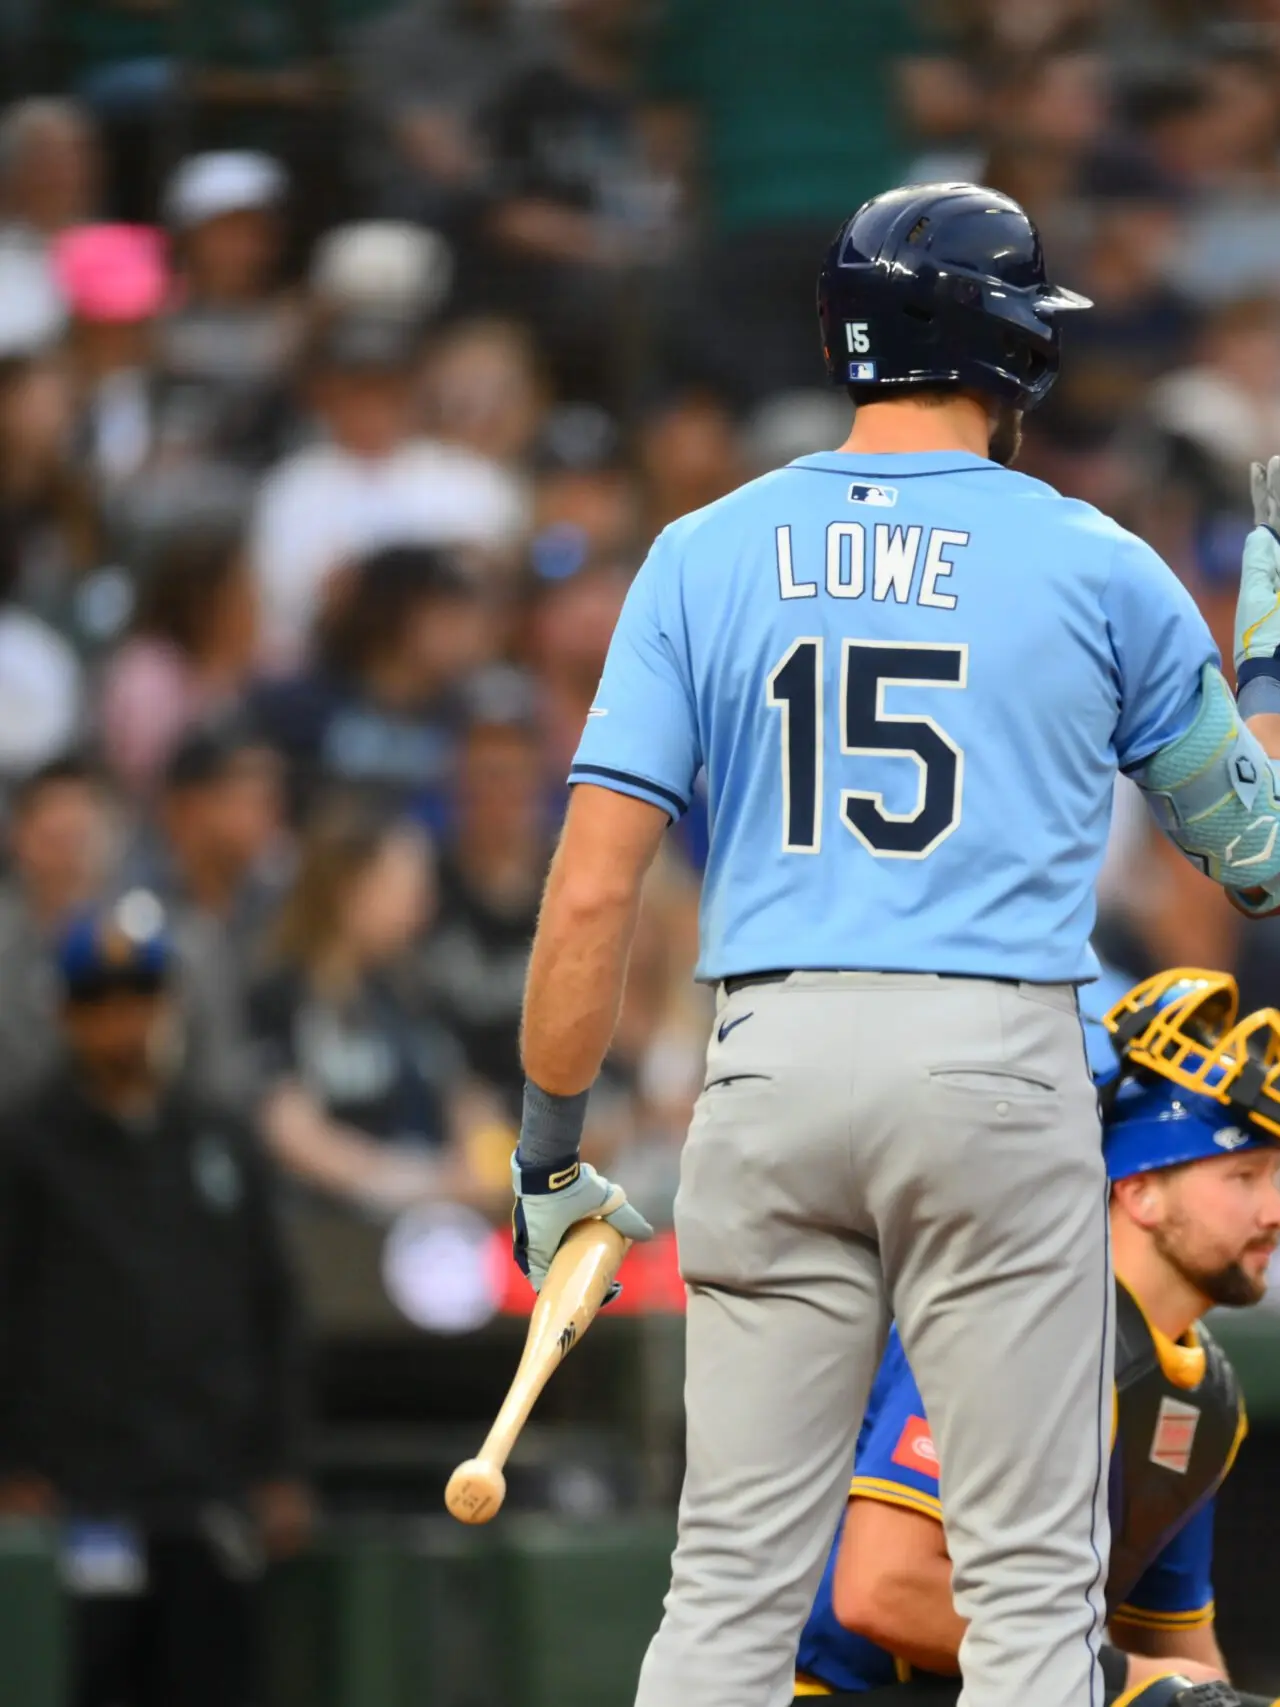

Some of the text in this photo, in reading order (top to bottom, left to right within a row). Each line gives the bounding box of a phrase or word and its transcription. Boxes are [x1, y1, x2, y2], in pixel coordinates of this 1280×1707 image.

[845, 322, 871, 353] 15
[775, 521, 970, 610] LOWE
[766, 636, 969, 860] 15
